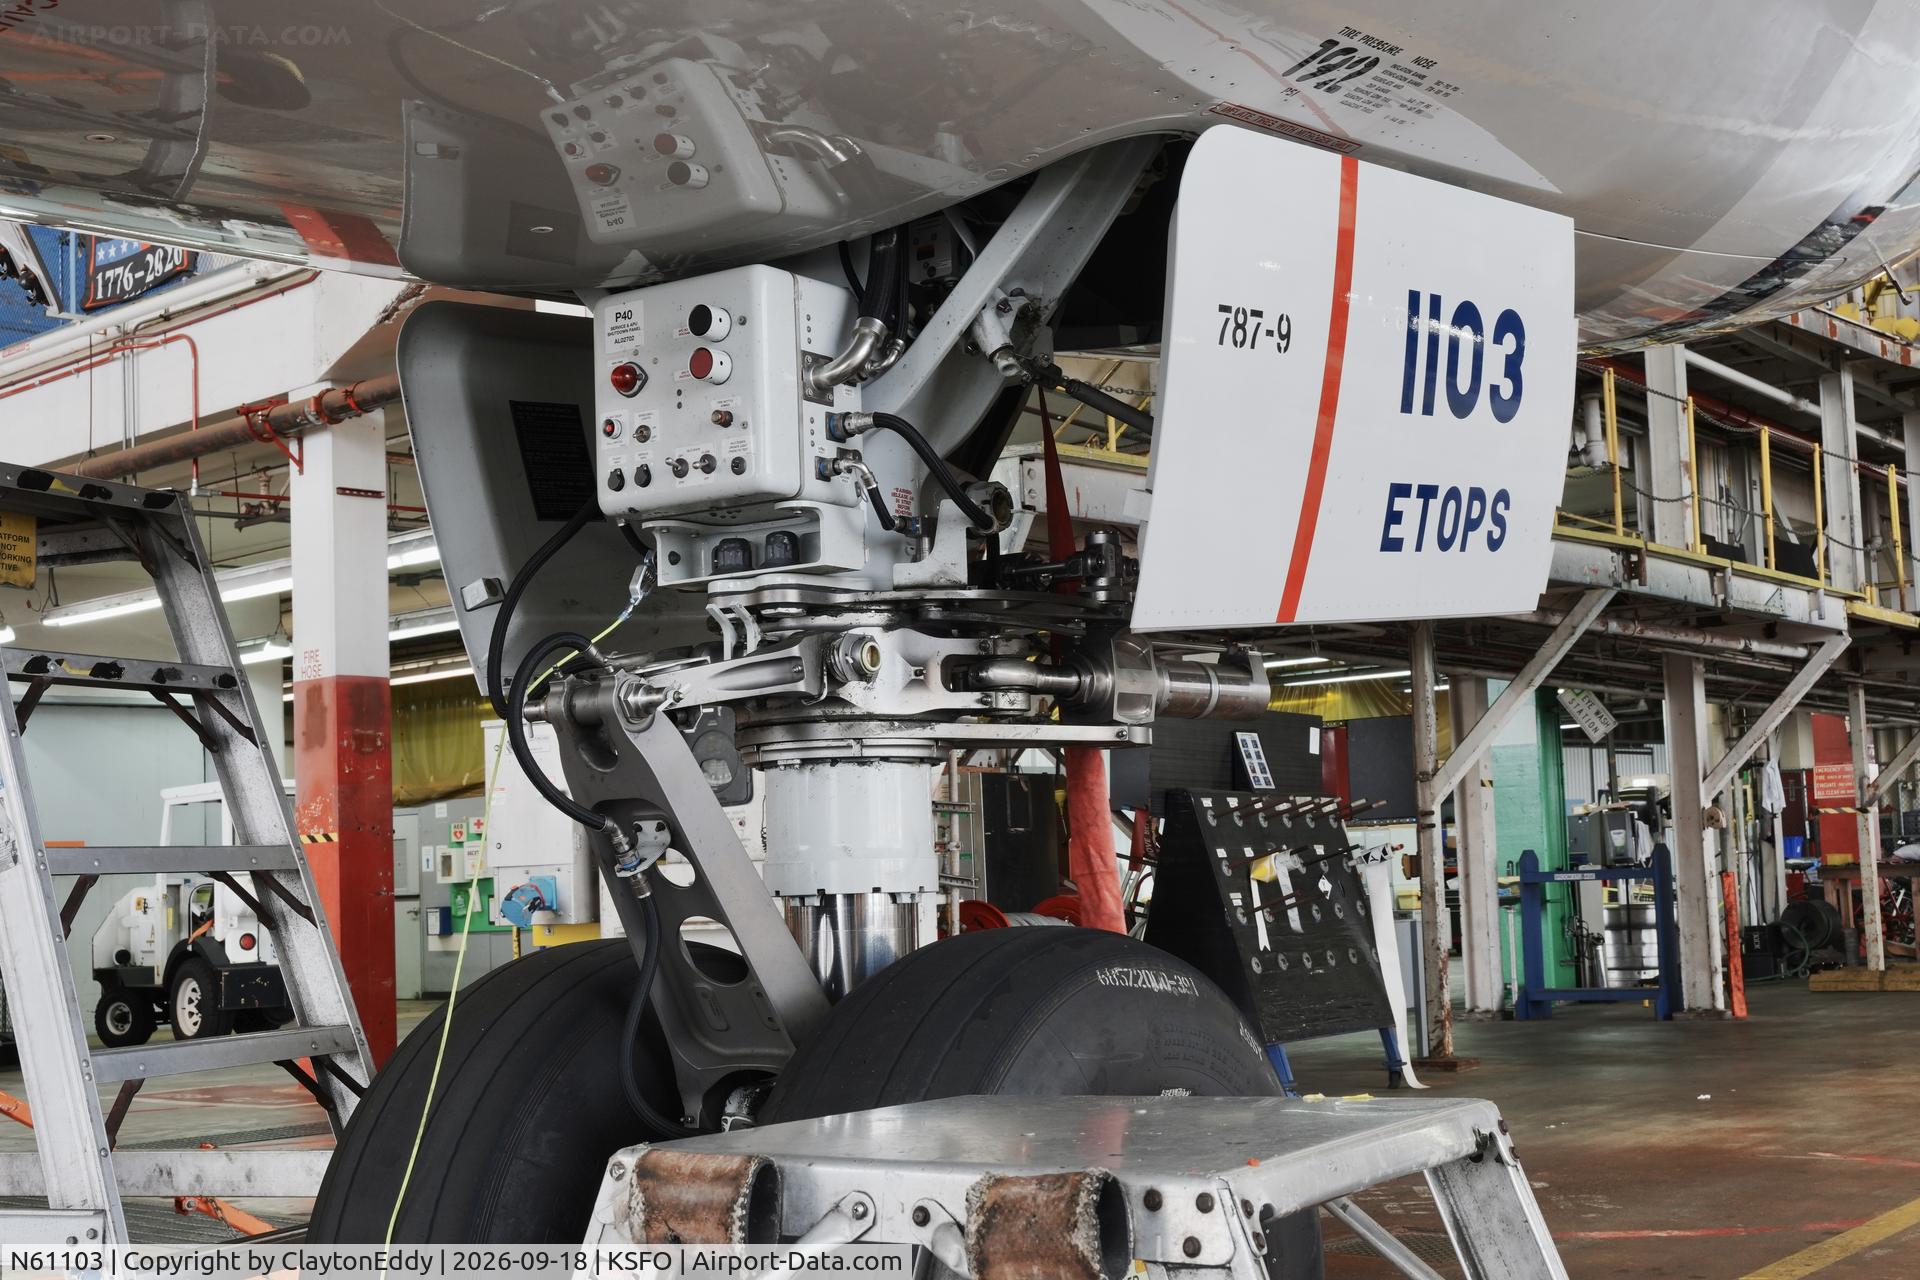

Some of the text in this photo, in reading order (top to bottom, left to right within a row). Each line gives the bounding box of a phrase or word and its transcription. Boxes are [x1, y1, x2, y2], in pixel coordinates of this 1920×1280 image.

[1337, 26, 1438, 70] TIRE PRESSURE NOSE
[1280, 86, 1301, 98] PSI
[615, 309, 634, 323] P40
[610, 323, 627, 332] SERVICE
[1218, 304, 1292, 354] 787-9
[1400, 289, 1526, 424] 1103
[1379, 482, 1511, 553] ETOPS
[0, 543, 16, 552] NOT
[0, 552, 32, 564] ORKING
[303, 648, 321, 665] FIRE
[300, 663, 323, 681] HOSE
[1567, 698, 1600, 735] STATION
[1581, 694, 1611, 729] EYE WASH
